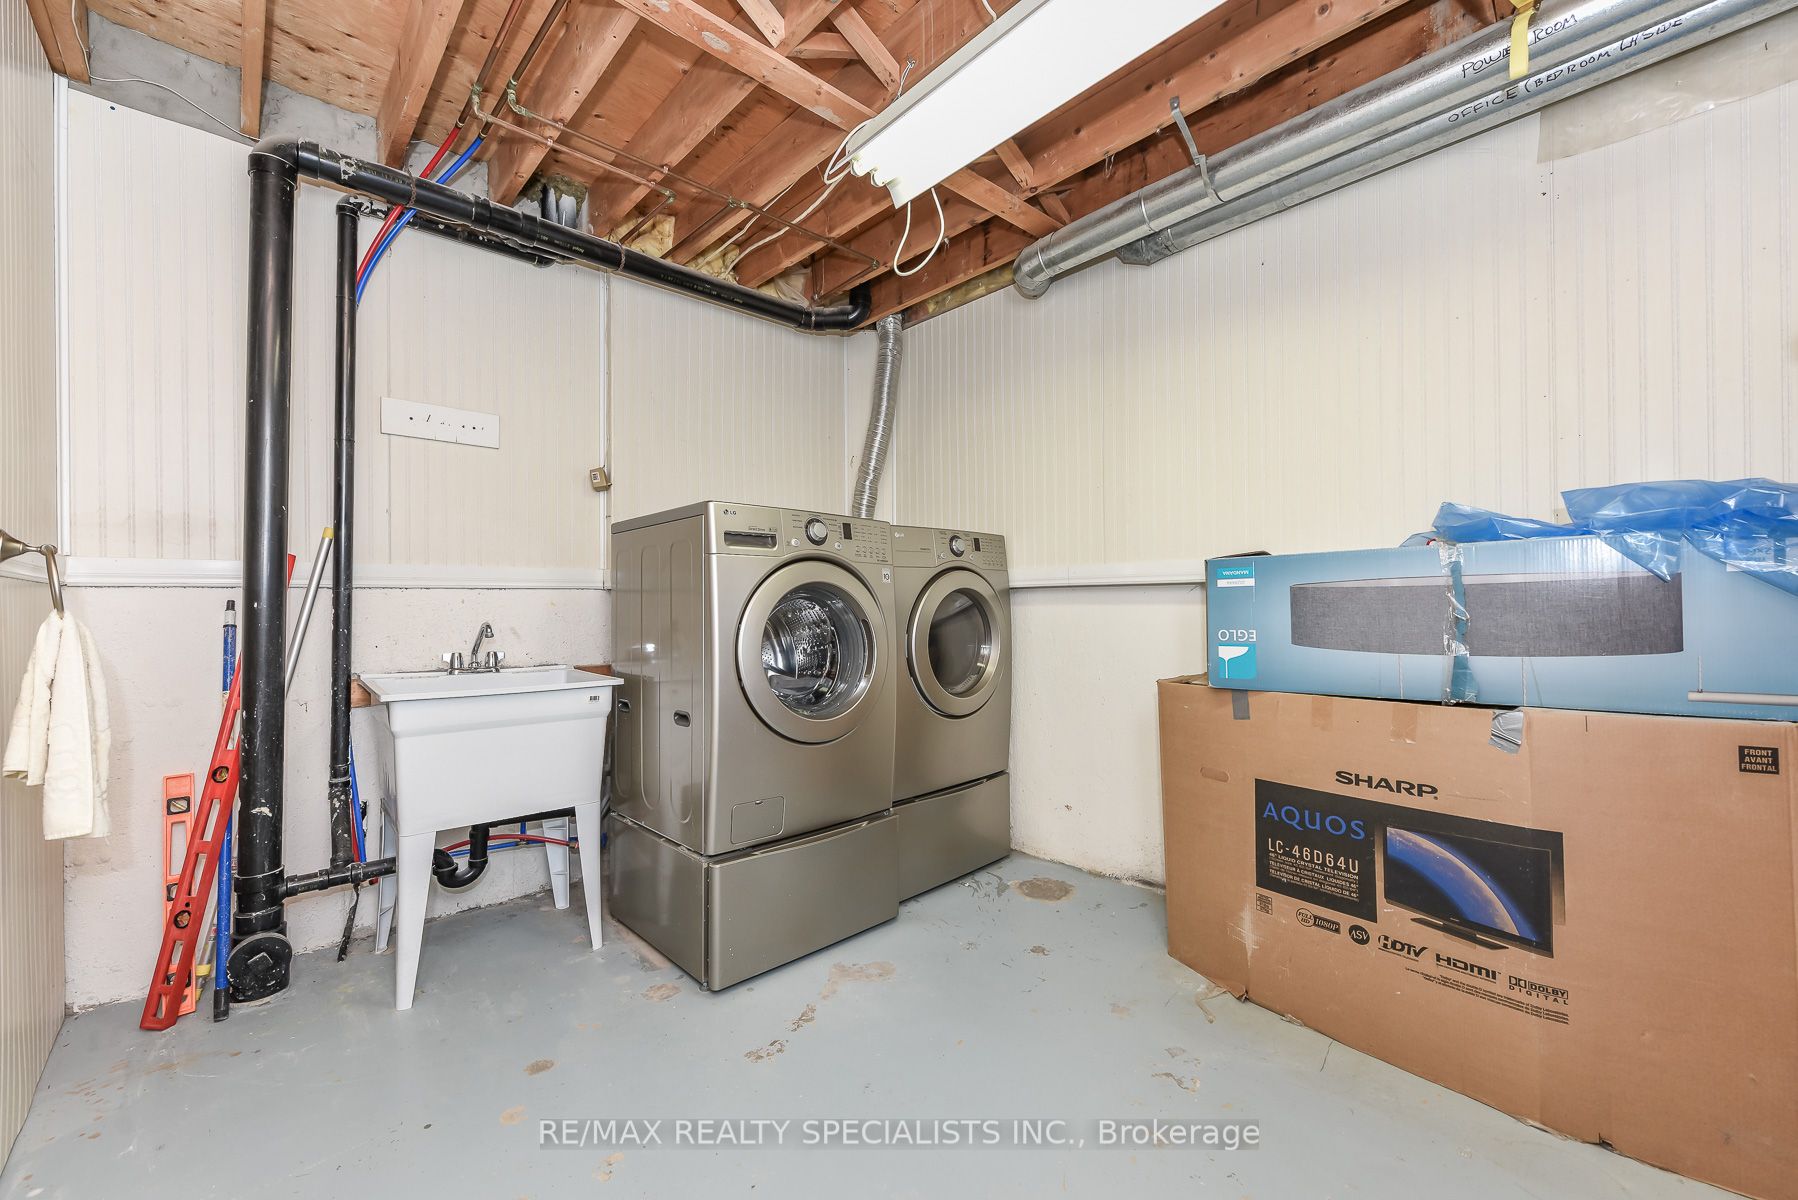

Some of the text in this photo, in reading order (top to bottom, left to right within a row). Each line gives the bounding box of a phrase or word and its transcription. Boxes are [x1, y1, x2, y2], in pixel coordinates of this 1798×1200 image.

[1533, 14, 1578, 43] ROOM
[1448, 85, 1519, 122] OFFICE
[1643, 19, 1683, 40] SIDE
[1218, 629, 1257, 642] EGLO
[1744, 748, 1772, 757] FRONT
[1744, 756, 1772, 764] AVANT
[1741, 763, 1777, 772] FRONTAL
[1335, 770, 1439, 798] SHARP
[1263, 802, 1366, 840] AQUOS
[1268, 838, 1359, 874] LC-46D64U
[1278, 854, 1296, 863] LIQUID
[1296, 860, 1323, 871] CRYSTAL
[1324, 867, 1359, 880] TELEVISION
[1301, 870, 1325, 880] CRISTAUX
[1326, 875, 1350, 887] LIQUIDES
[1301, 879, 1321, 888] CRISTAL
[1315, 918, 1339, 931] 1080P
[1435, 953, 1497, 980] HDMI
[1508, 984, 1569, 1005] DIGITAL
[1530, 983, 1566, 998] DOLBY
